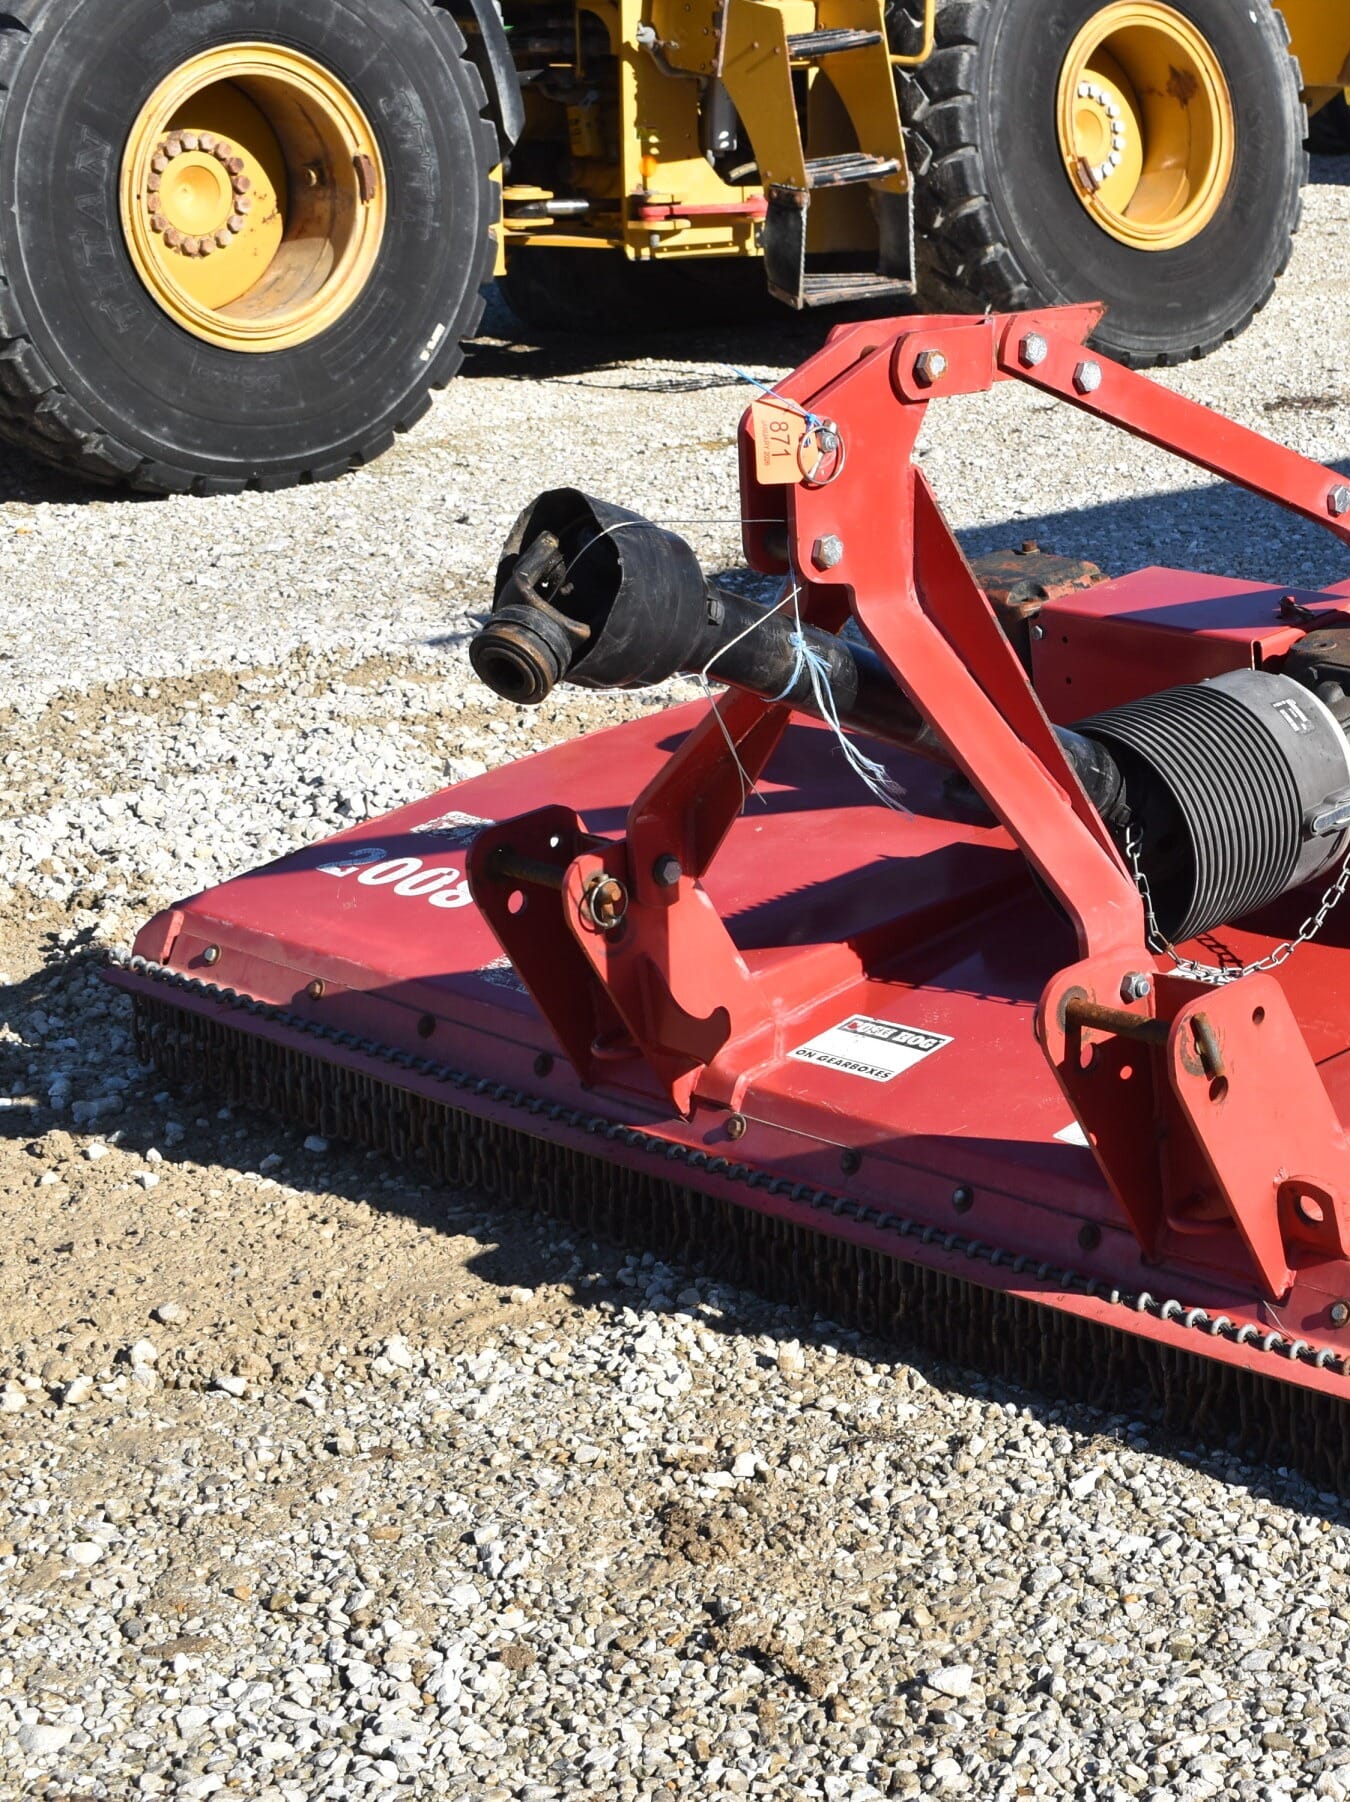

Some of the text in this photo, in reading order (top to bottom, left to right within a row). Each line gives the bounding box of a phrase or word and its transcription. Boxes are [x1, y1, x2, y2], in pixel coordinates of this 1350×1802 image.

[769, 421, 792, 457] 871
[795, 1049, 893, 1080] ON GEARBOXES
